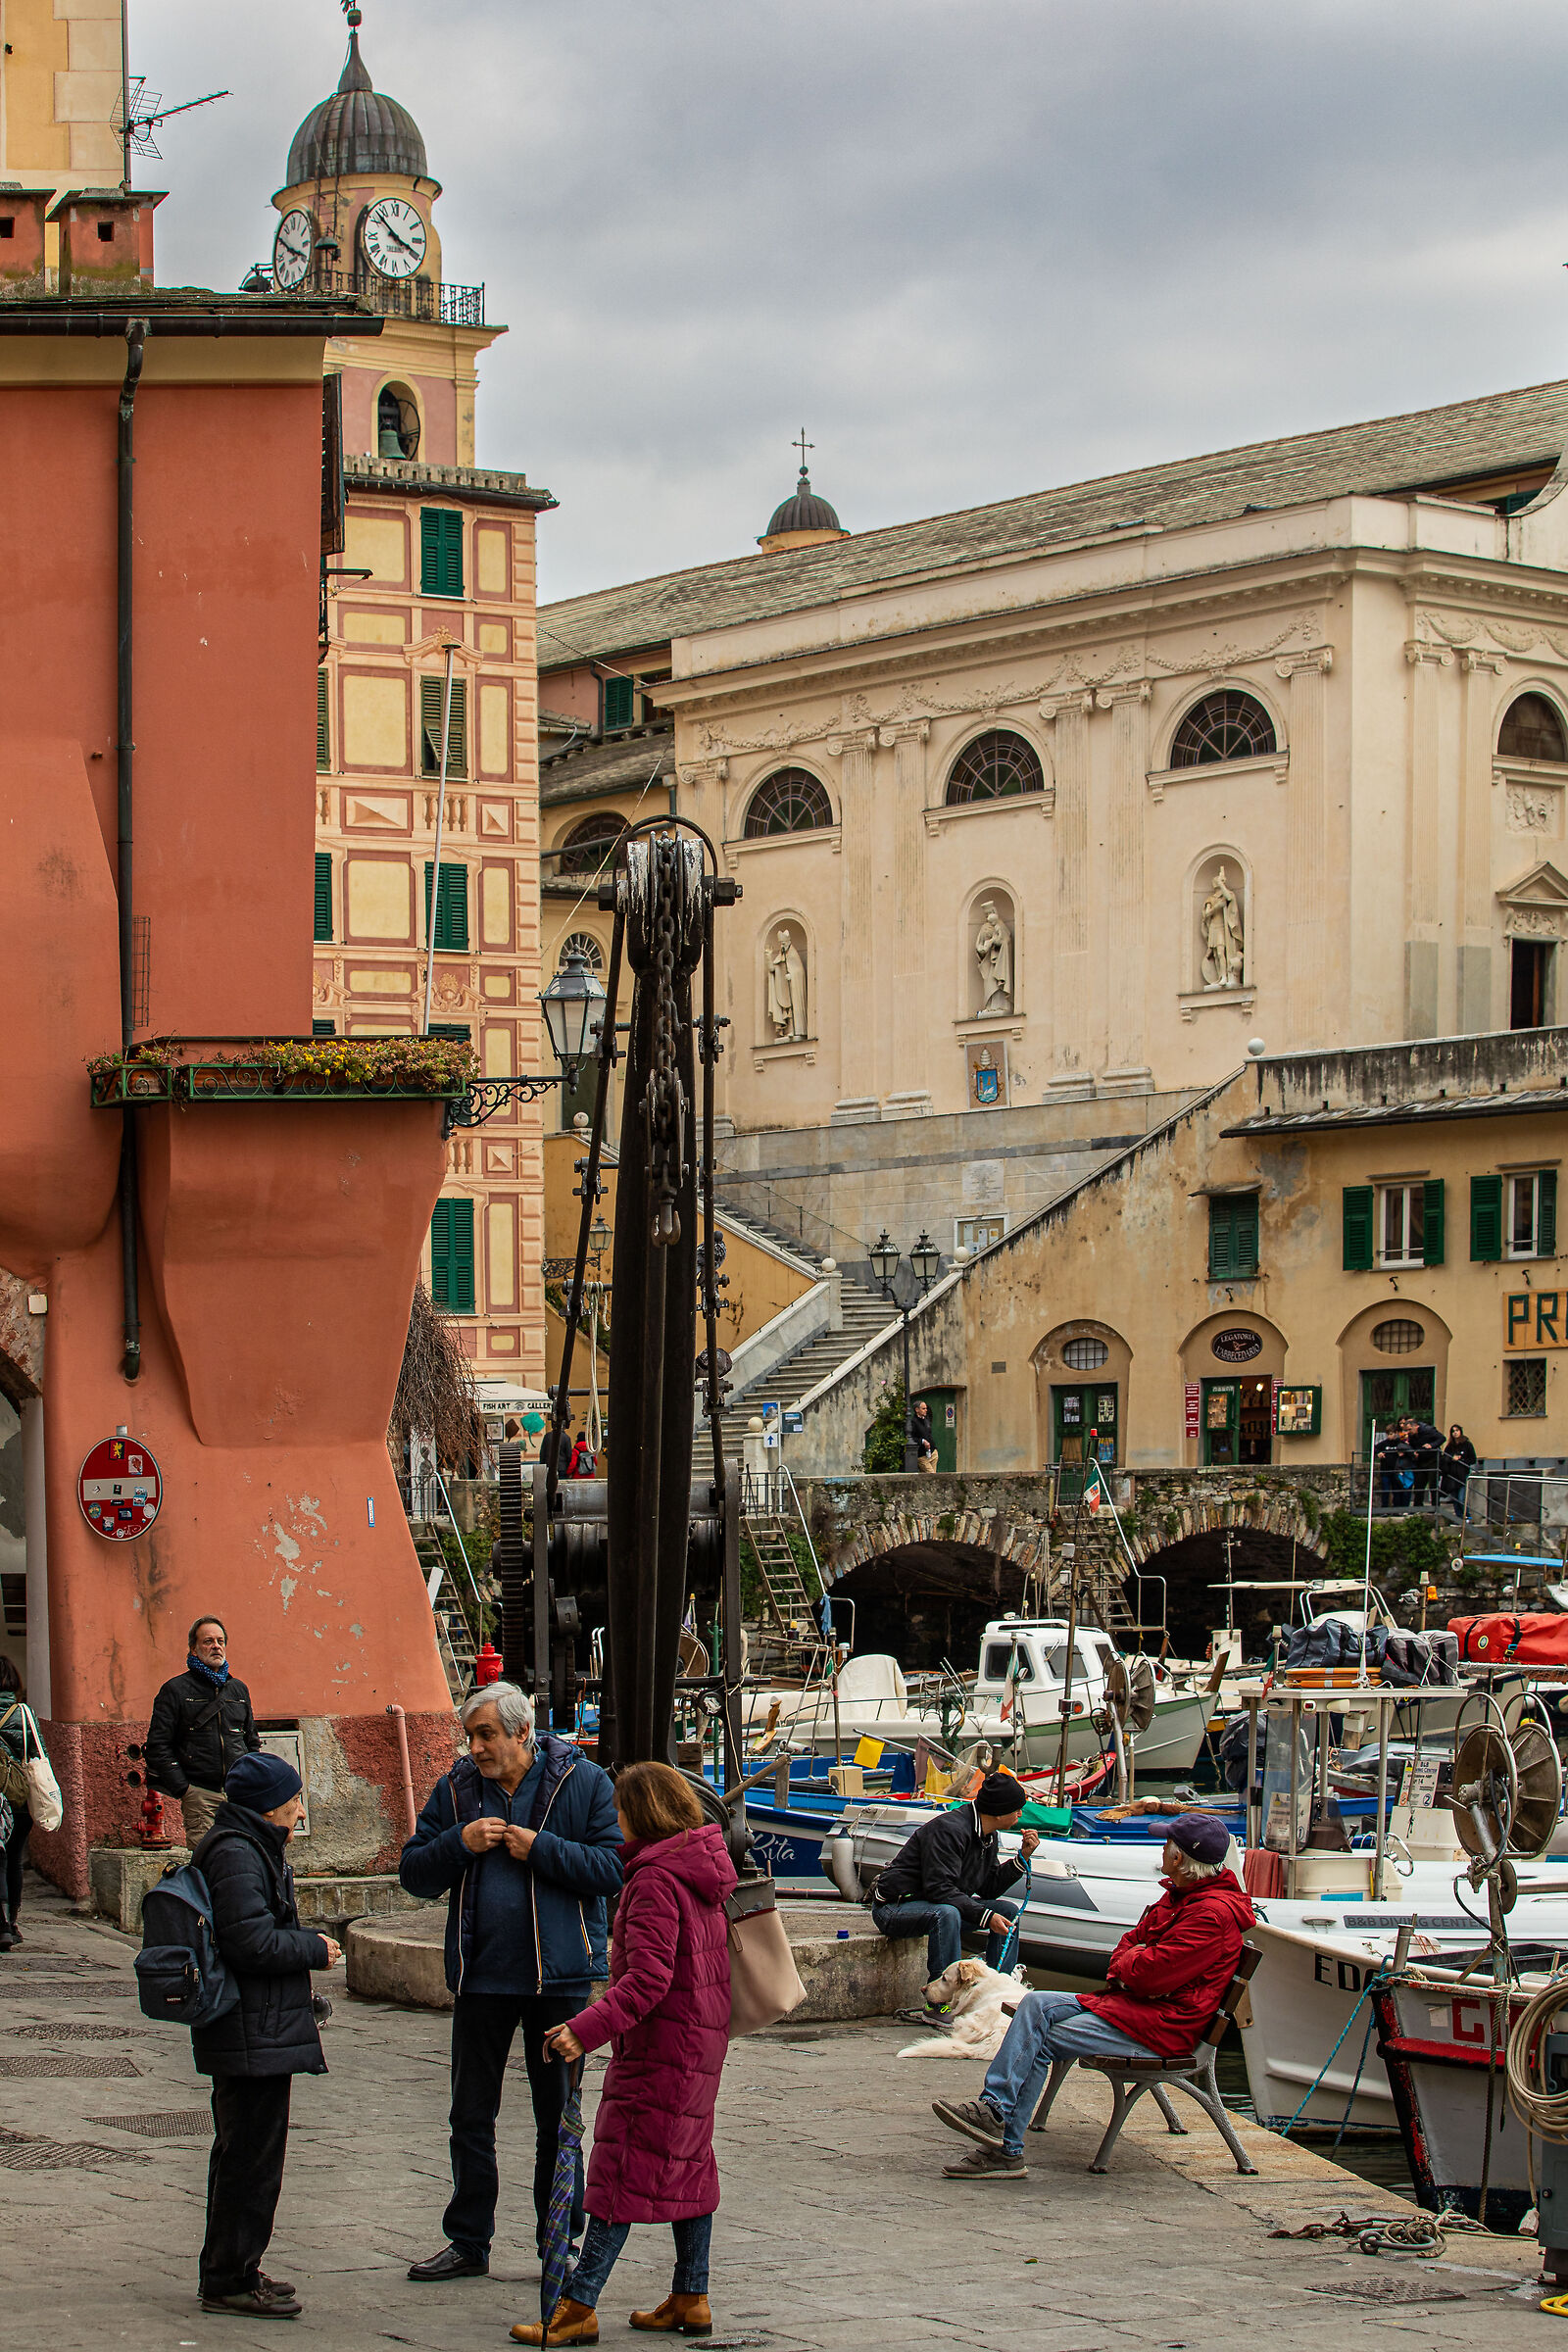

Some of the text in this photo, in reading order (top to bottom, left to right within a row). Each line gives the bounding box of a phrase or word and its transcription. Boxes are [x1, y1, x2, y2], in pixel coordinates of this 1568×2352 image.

[1508, 1292, 1568, 1343] PR
[1221, 1334, 1255, 1343] LEGATORIA
[747, 1834, 797, 1863] Rita
[1348, 1917, 1376, 1927] B&B
